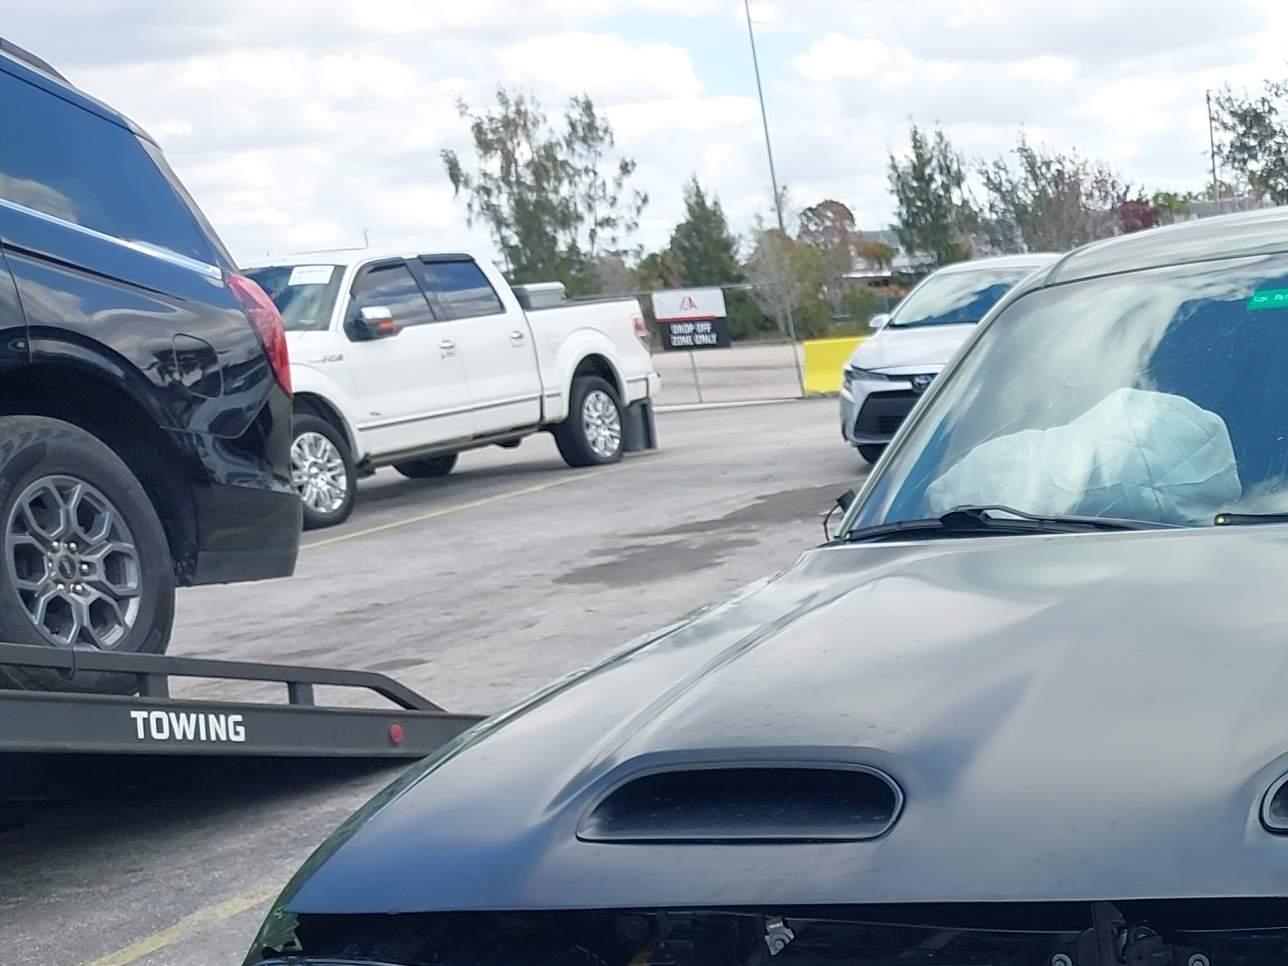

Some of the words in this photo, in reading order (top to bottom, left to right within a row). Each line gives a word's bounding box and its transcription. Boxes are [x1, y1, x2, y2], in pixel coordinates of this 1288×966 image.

[670, 322, 695, 335] DROP
[695, 321, 712, 333] OFF
[694, 332, 717, 345] ONLY
[130, 710, 246, 742] TOWING
